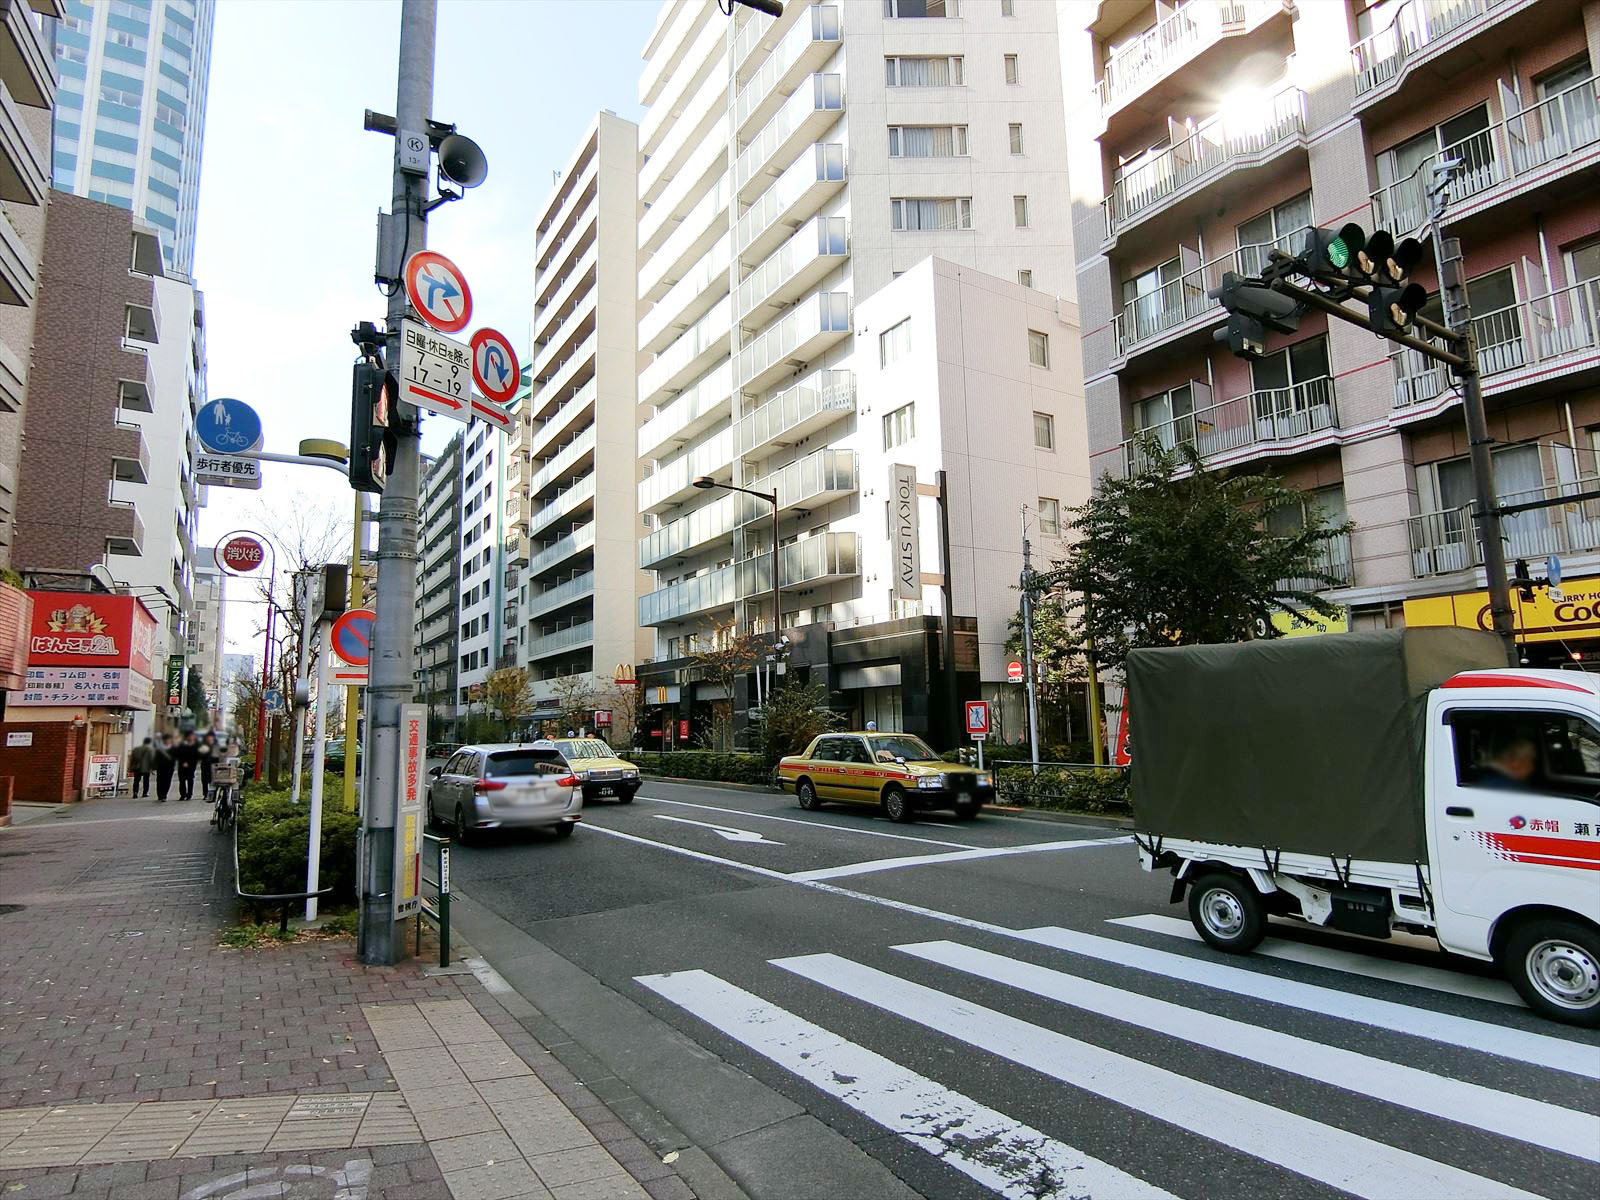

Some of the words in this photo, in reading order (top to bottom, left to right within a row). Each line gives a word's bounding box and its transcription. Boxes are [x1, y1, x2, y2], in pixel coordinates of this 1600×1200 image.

[407, 329, 469, 367] 日曜・休日を除く
[197, 458, 255, 475] 歩行者優先
[899, 475, 912, 537] TOKYU
[227, 546, 261, 562] 消火栓
[901, 542, 914, 588] STAY
[405, 719, 419, 801] 交通事故多発
[1529, 819, 1559, 833] 赤帽
